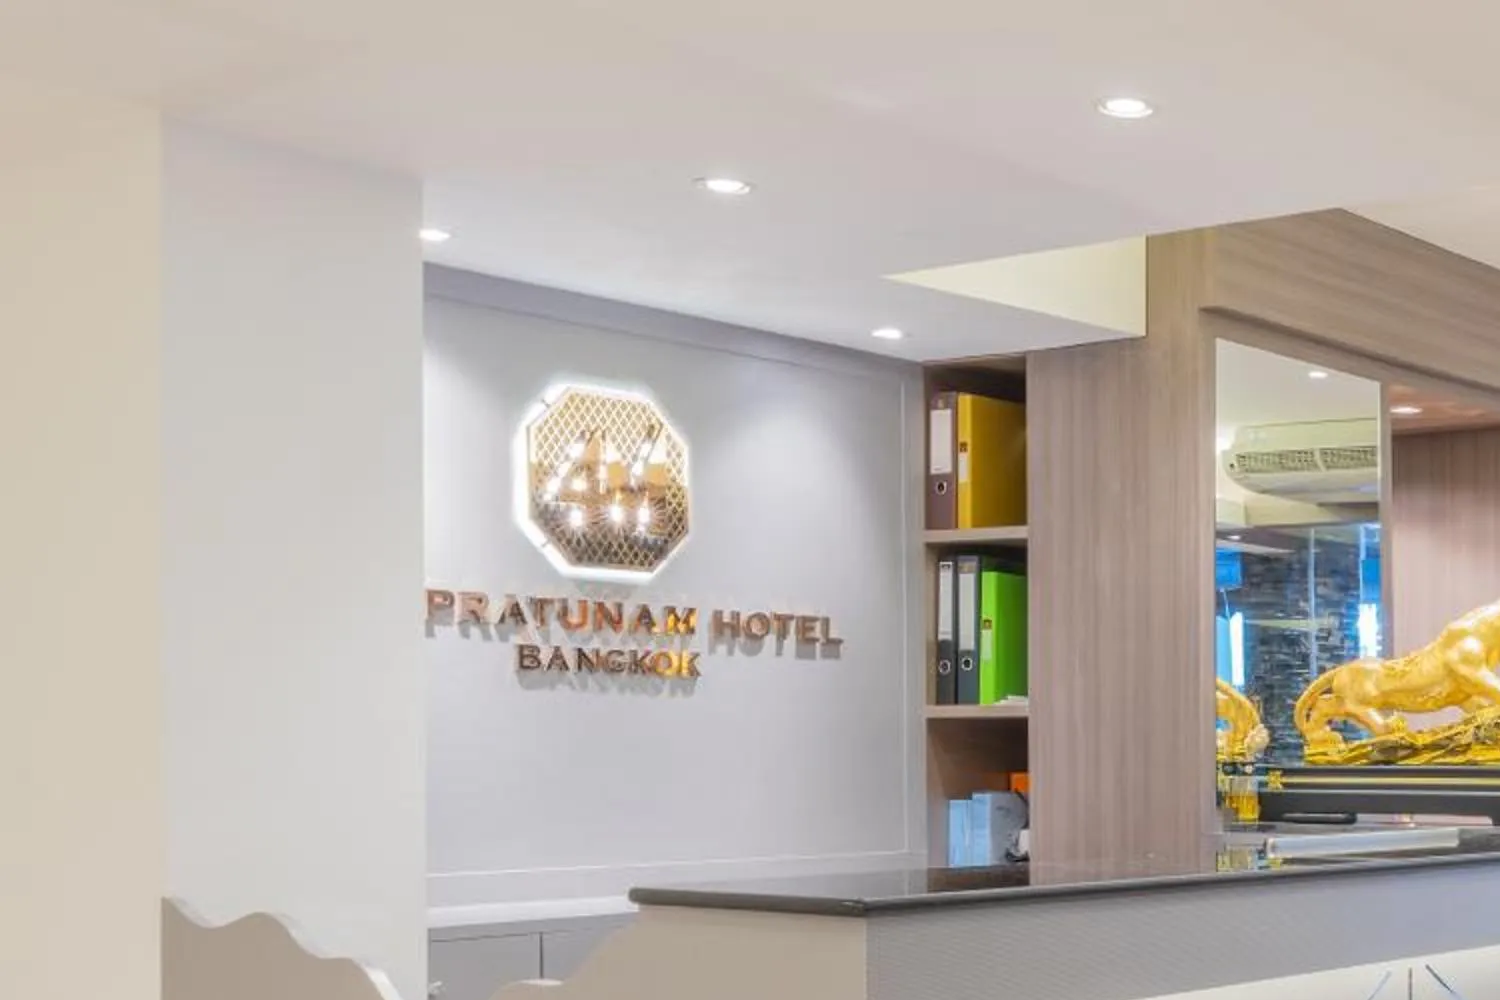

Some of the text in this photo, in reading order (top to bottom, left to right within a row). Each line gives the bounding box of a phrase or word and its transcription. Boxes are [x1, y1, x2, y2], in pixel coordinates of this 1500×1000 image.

[424, 588, 845, 645] PRATUNAM HOTEL
[515, 643, 702, 677] BANGKOK
